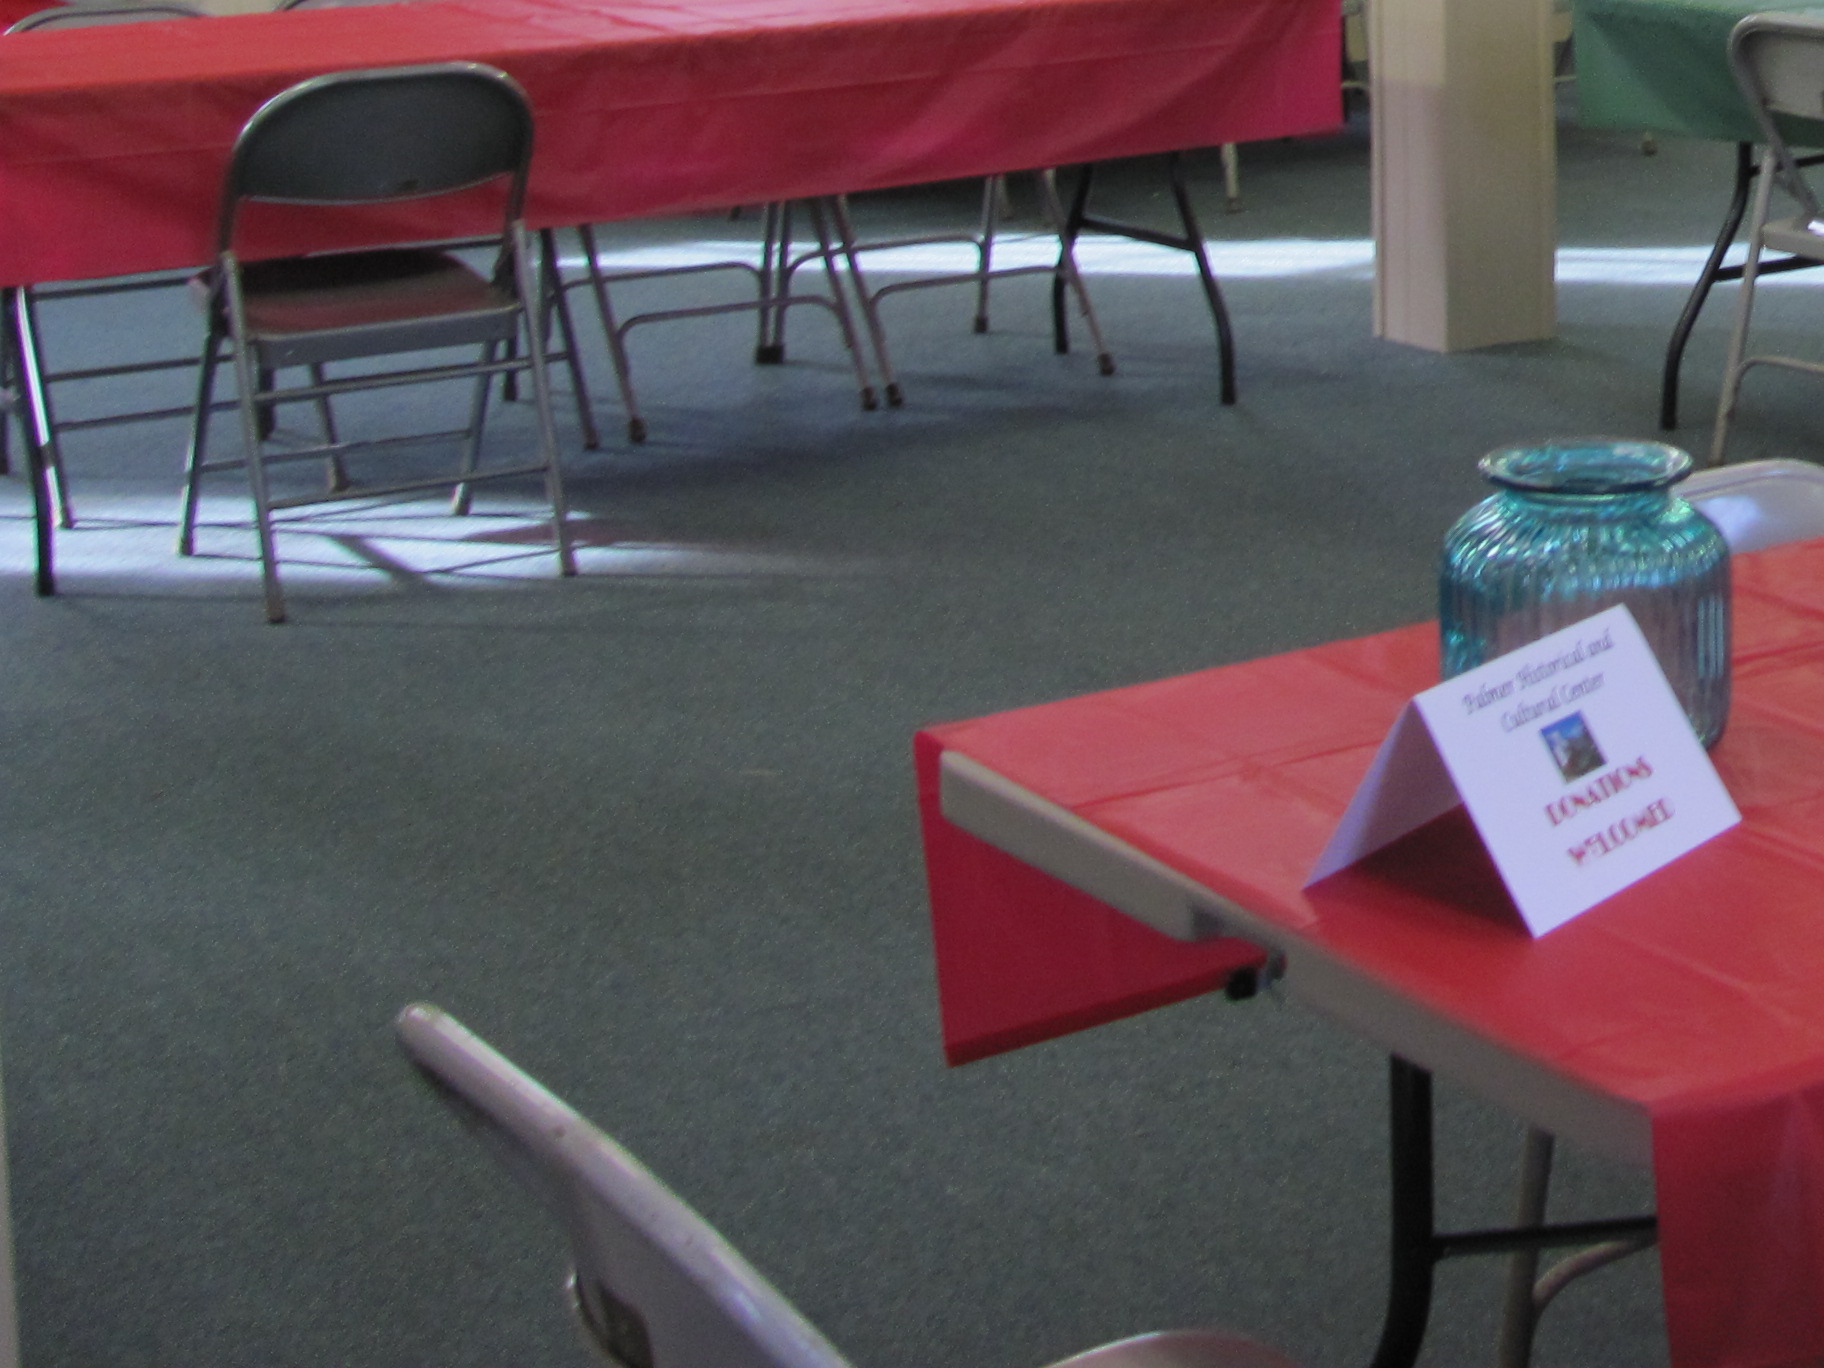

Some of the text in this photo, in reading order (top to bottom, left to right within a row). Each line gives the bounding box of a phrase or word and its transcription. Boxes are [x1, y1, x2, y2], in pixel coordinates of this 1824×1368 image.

[1587, 627, 1614, 656] and
[1501, 672, 1604, 732] Cultural Center
[1544, 755, 1654, 827] DONATIONS
[1566, 796, 1677, 867] WELCOME
